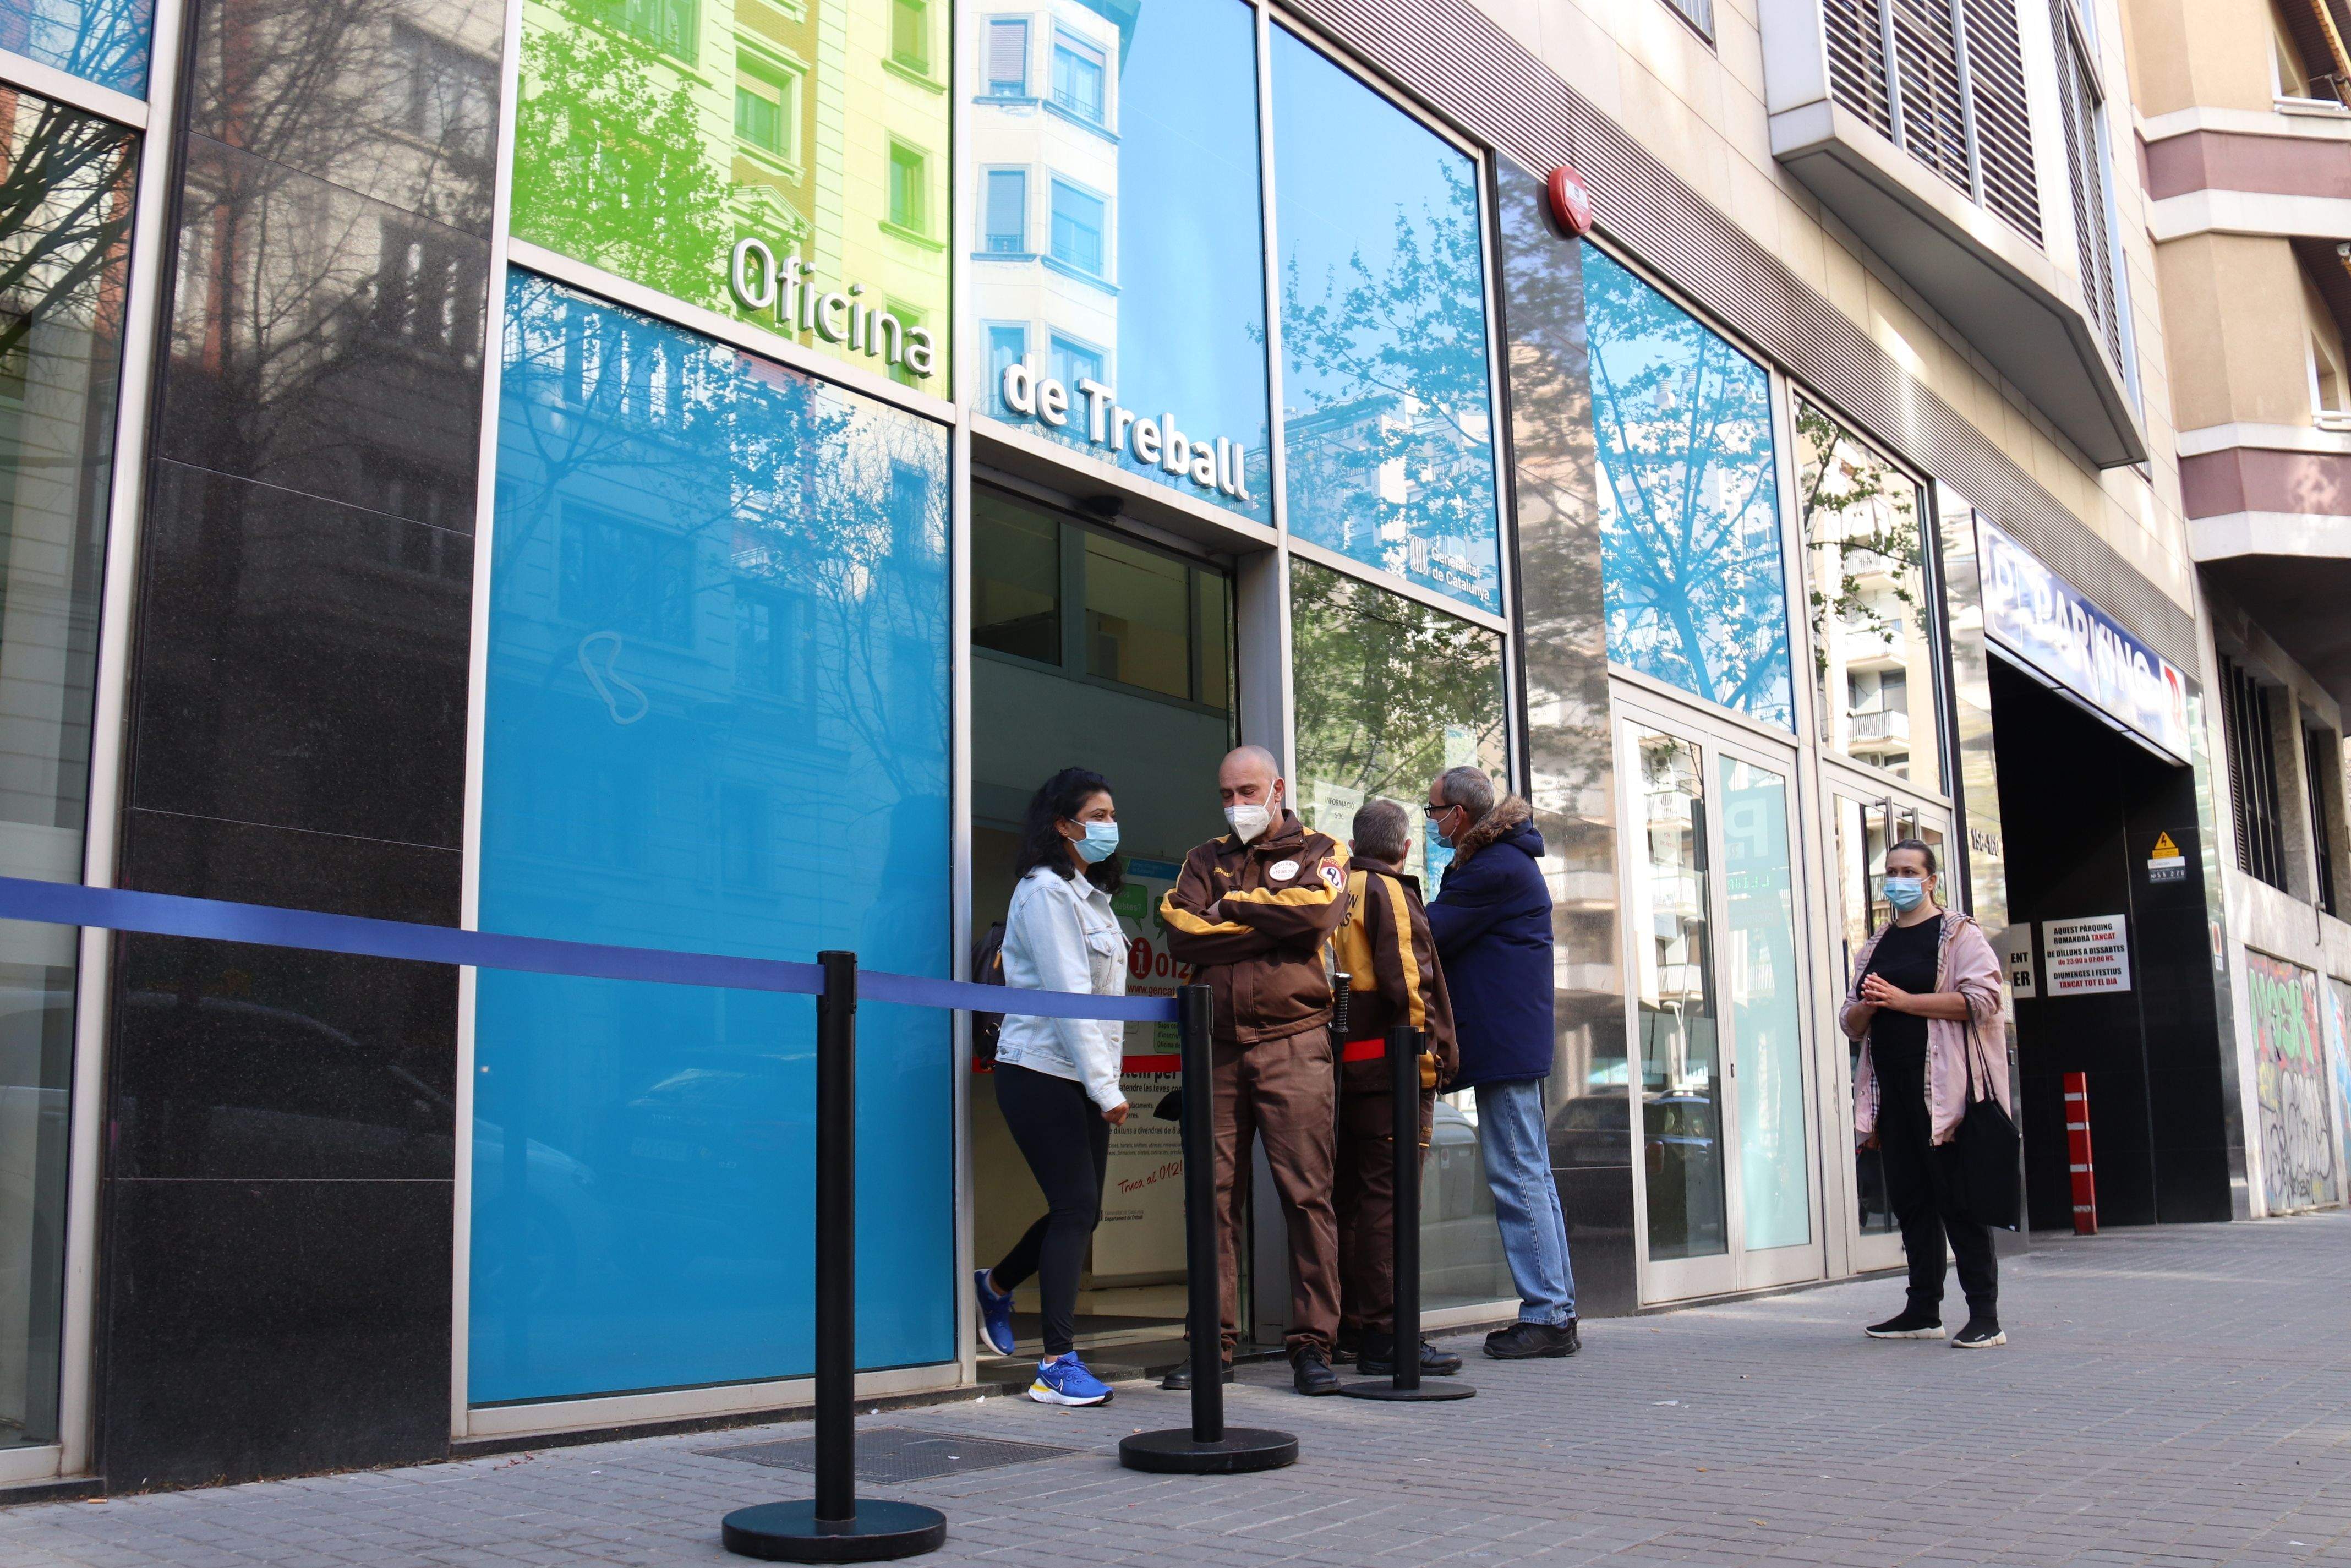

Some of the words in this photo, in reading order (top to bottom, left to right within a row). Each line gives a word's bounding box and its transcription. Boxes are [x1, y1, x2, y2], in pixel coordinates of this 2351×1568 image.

[732, 237, 936, 378] Oficina
[1003, 353, 1068, 427] de
[1079, 378, 1249, 500] Treball
[1431, 547, 1481, 578] Generalitat
[1432, 567, 1444, 582] de
[1446, 572, 1490, 601] Catalunya
[1325, 796, 1355, 810] INFORMACIÓ
[2054, 926, 2078, 935] AQUEST
[2080, 923, 2113, 933] PÀRQUING
[2091, 932, 2115, 941] TANCAT
[2057, 948, 2082, 957] DILLUNS
[2089, 945, 2125, 955] DISSABTES
[2054, 969, 2091, 979] DIUMENGES
[2096, 967, 2122, 976] FESTIUS
[2059, 980, 2084, 988] TANCAT
[1144, 1084, 1152, 1092] les
[1153, 1084, 1170, 1092] teves
[1114, 1127, 1132, 1135] dilluns
[1138, 1127, 1163, 1135] divendres
[1118, 1179, 1144, 1194] Truca
[1147, 1171, 1157, 1184] al
[1160, 1160, 1183, 1179] 012!
